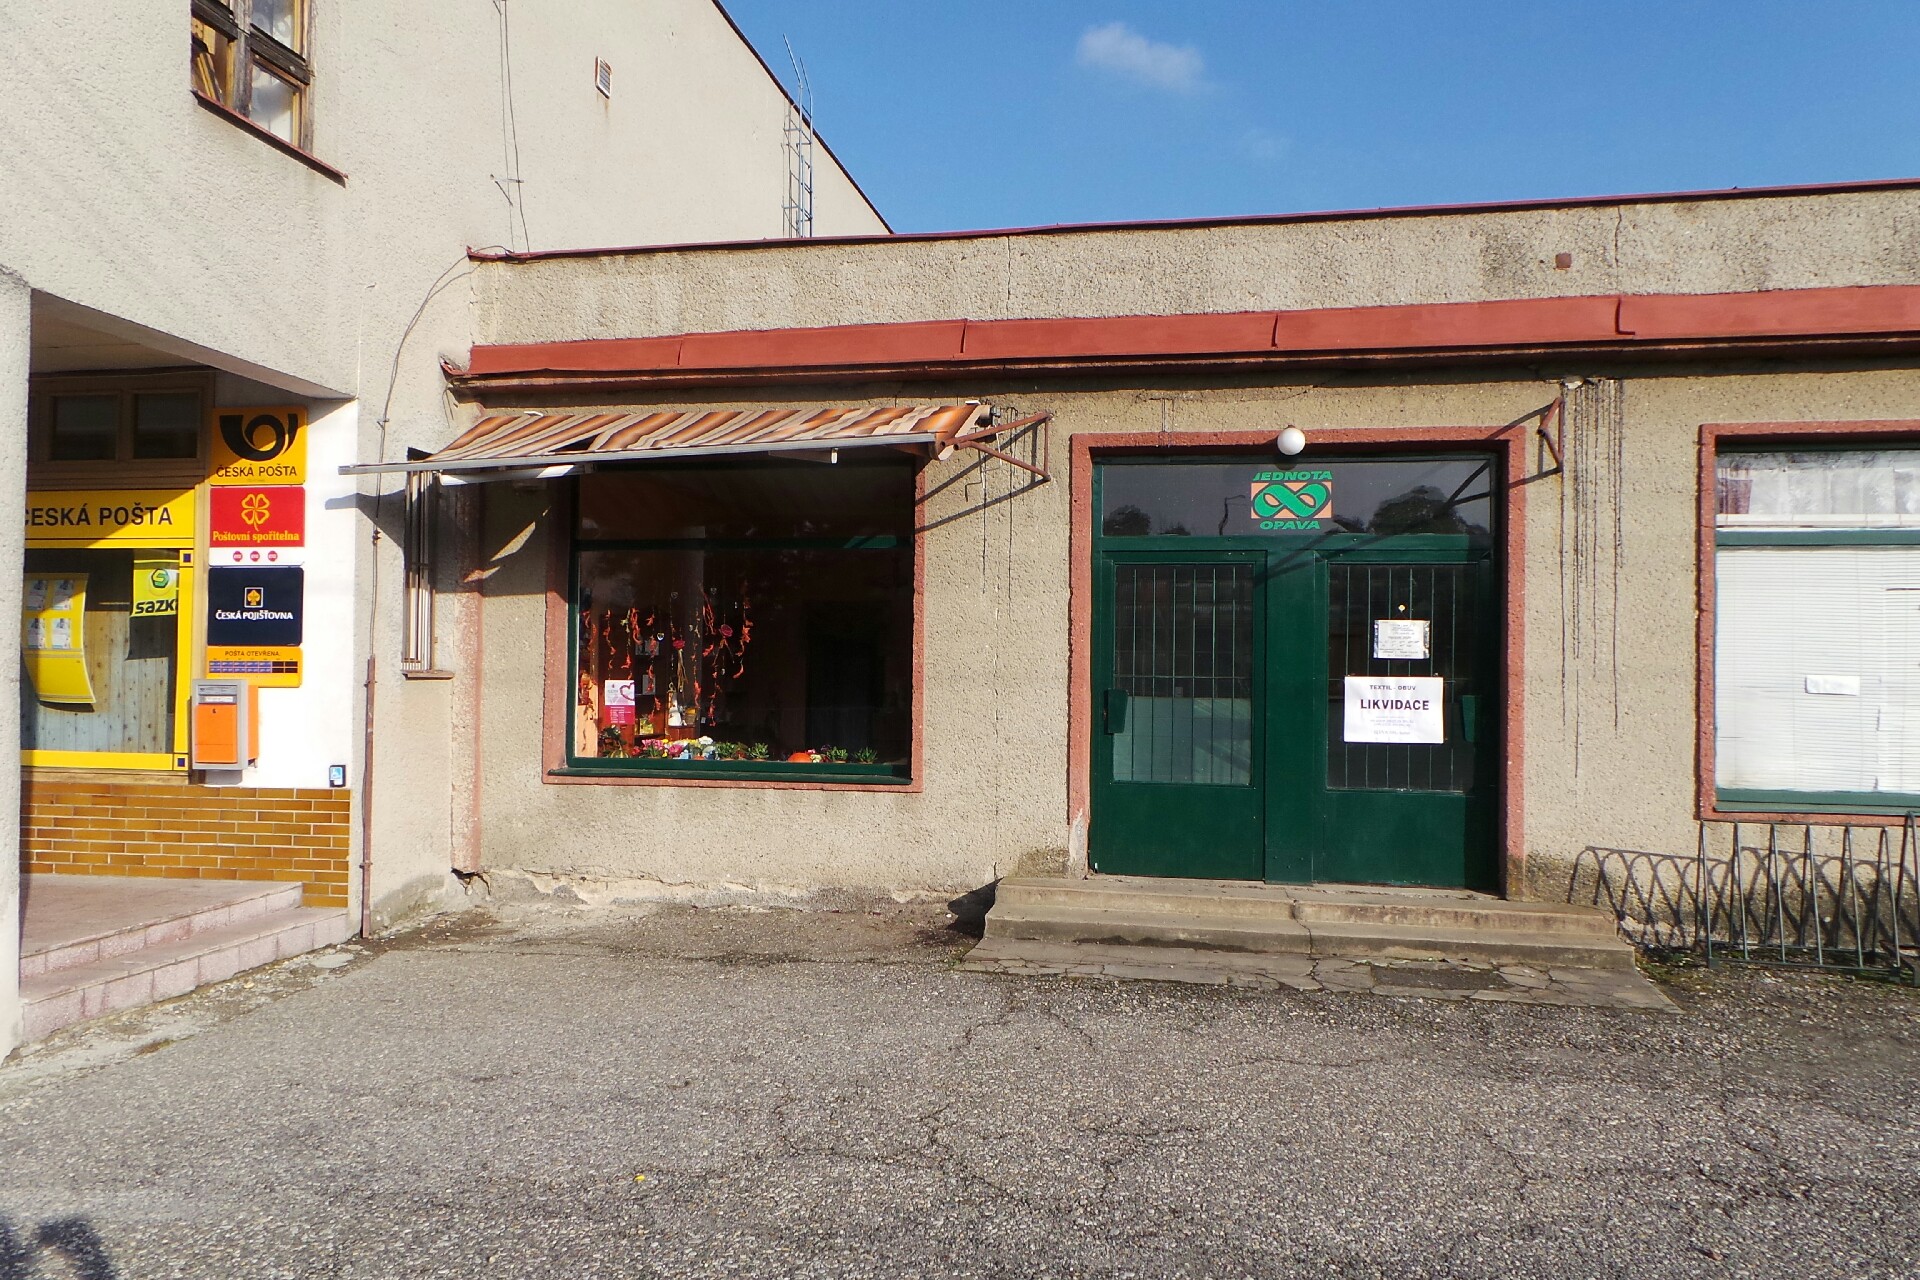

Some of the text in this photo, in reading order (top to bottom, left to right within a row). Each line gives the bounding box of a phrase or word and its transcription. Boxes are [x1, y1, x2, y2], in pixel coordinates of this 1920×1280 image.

[216, 463, 297, 477] ČESKÁ POŠTA
[1253, 471, 1332, 481] JEDNOTA
[99, 502, 173, 526] POŠTA
[1260, 521, 1320, 530] OPAVA
[213, 530, 299, 543] Poštovní spořitelna
[216, 610, 293, 620] ČESKÁ POJIŠŤOVNA
[1360, 699, 1429, 710] LIKVIDACE
